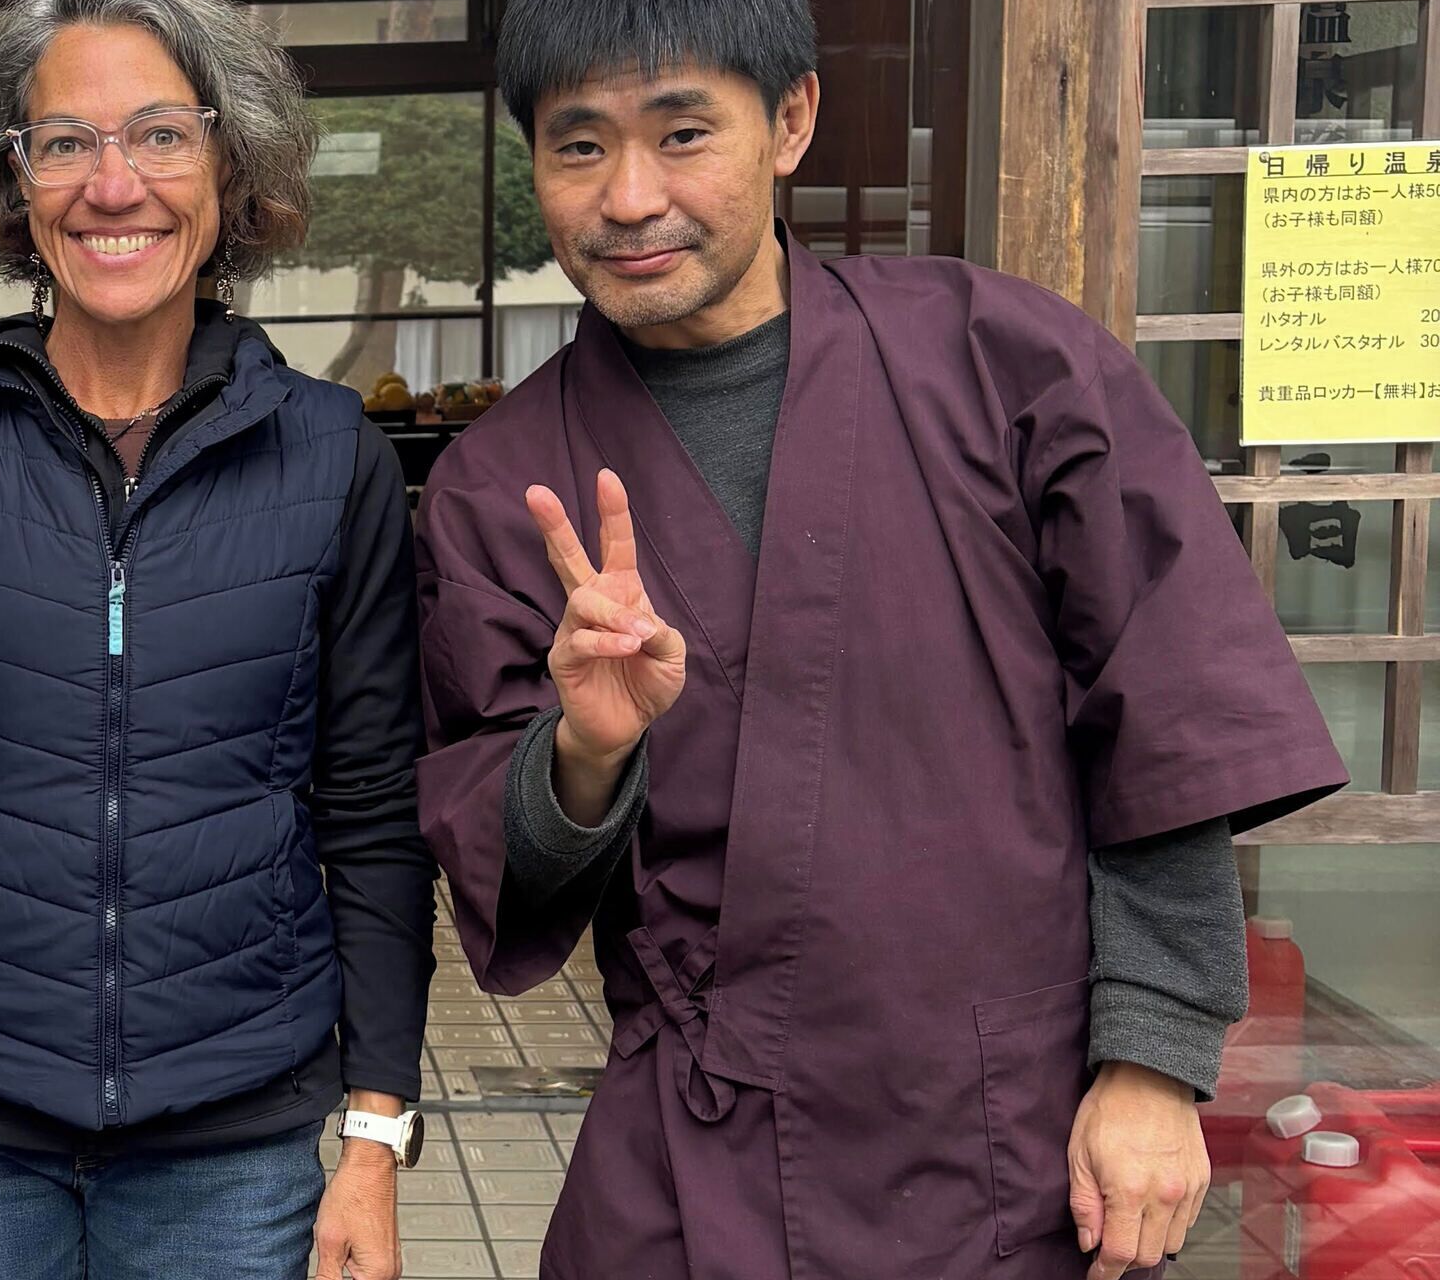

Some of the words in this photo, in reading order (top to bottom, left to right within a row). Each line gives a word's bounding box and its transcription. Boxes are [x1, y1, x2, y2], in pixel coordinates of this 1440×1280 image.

[1264, 209, 1383, 228] （お子様も同額）
[1262, 284, 1382, 303] （お子様も同額）
[1260, 311, 1327, 327] 小タオル
[1260, 333, 1405, 351] レンタルバスタオル
